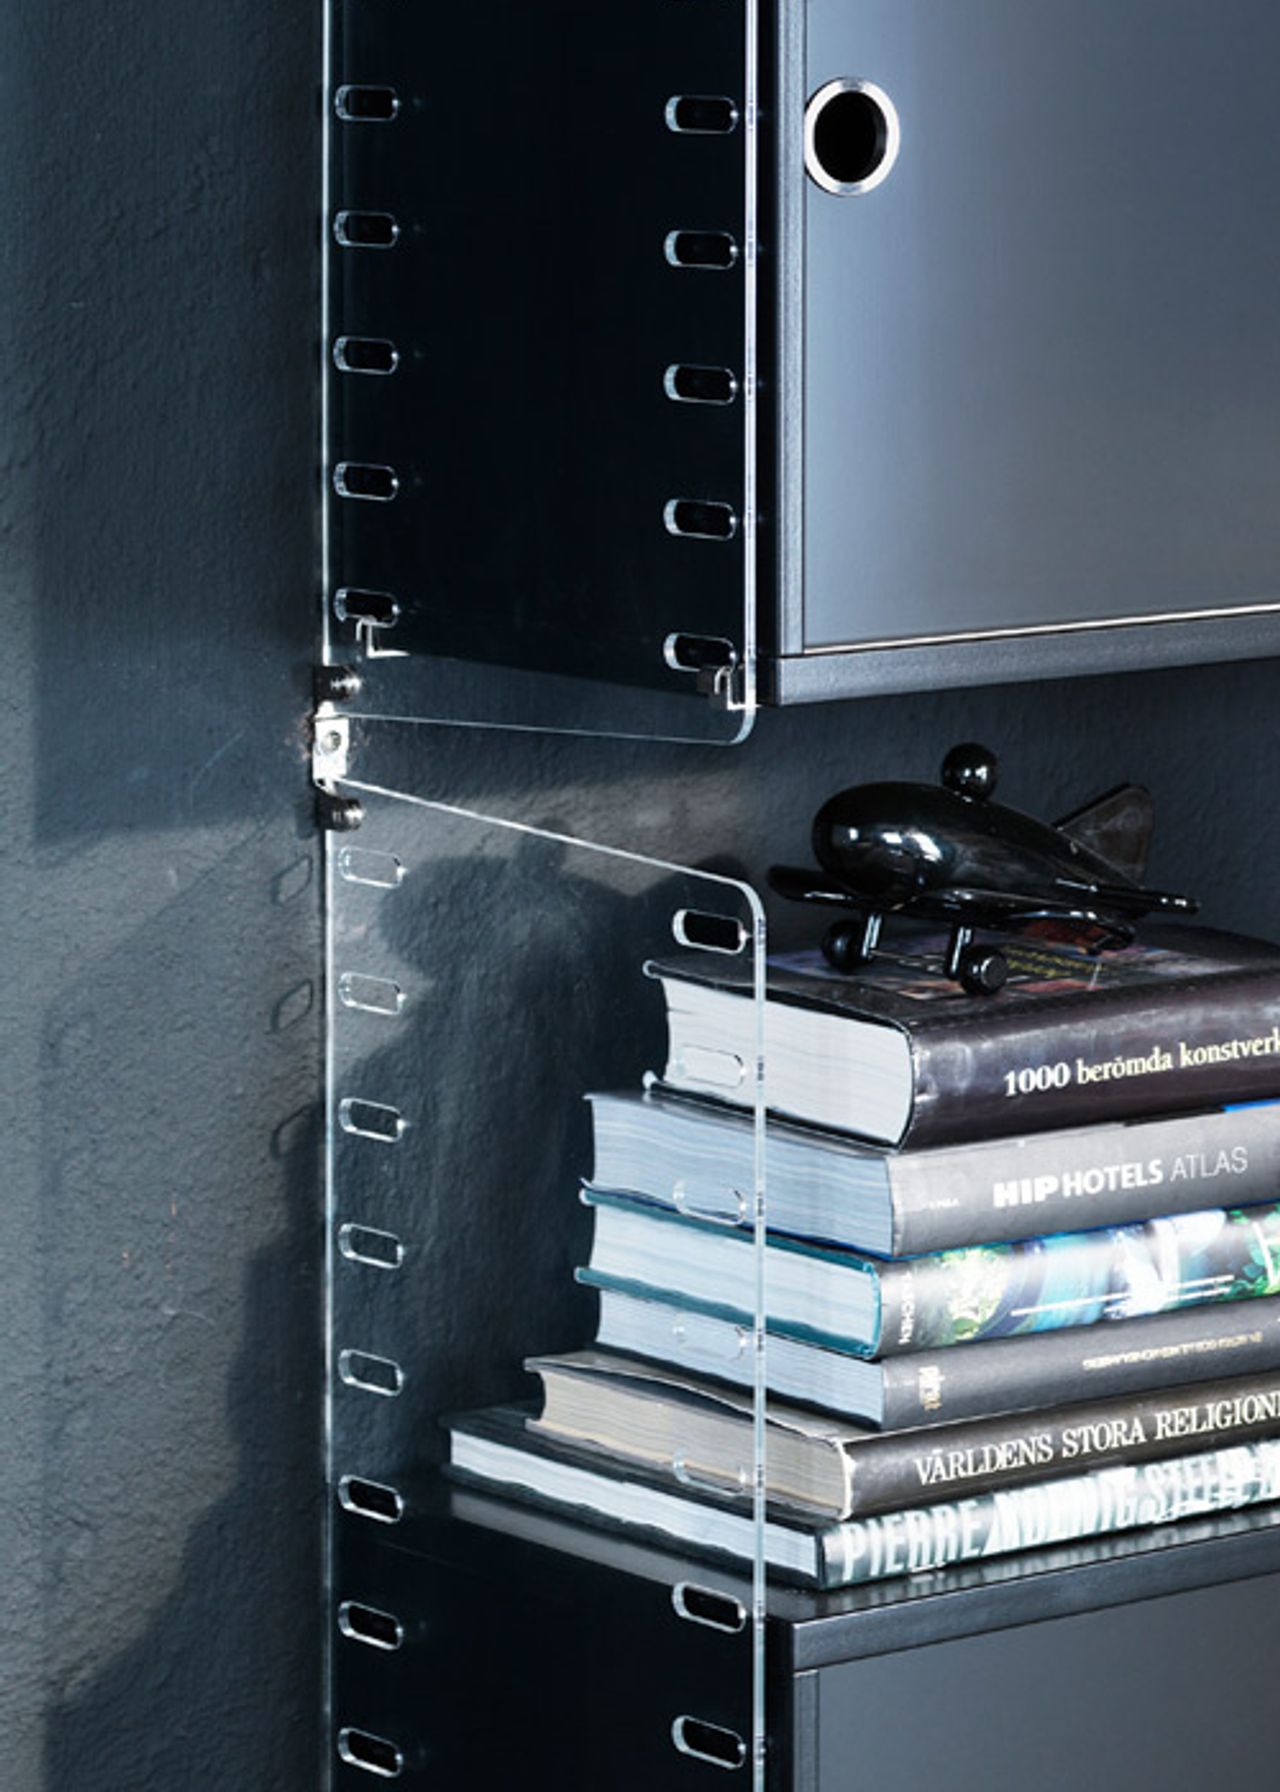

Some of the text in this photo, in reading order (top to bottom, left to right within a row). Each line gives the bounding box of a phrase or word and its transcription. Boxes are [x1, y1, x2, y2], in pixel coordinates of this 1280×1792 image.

[1004, 1062, 1071, 1098] 1000
[1077, 1045, 1174, 1085] berömda
[993, 1146, 1249, 1208] HIP HOTELS ATLAS
[914, 1438, 1054, 1487] VÄRLDENS
[1061, 1423, 1147, 1462] STORA
[839, 1499, 984, 1582] PIERRE
